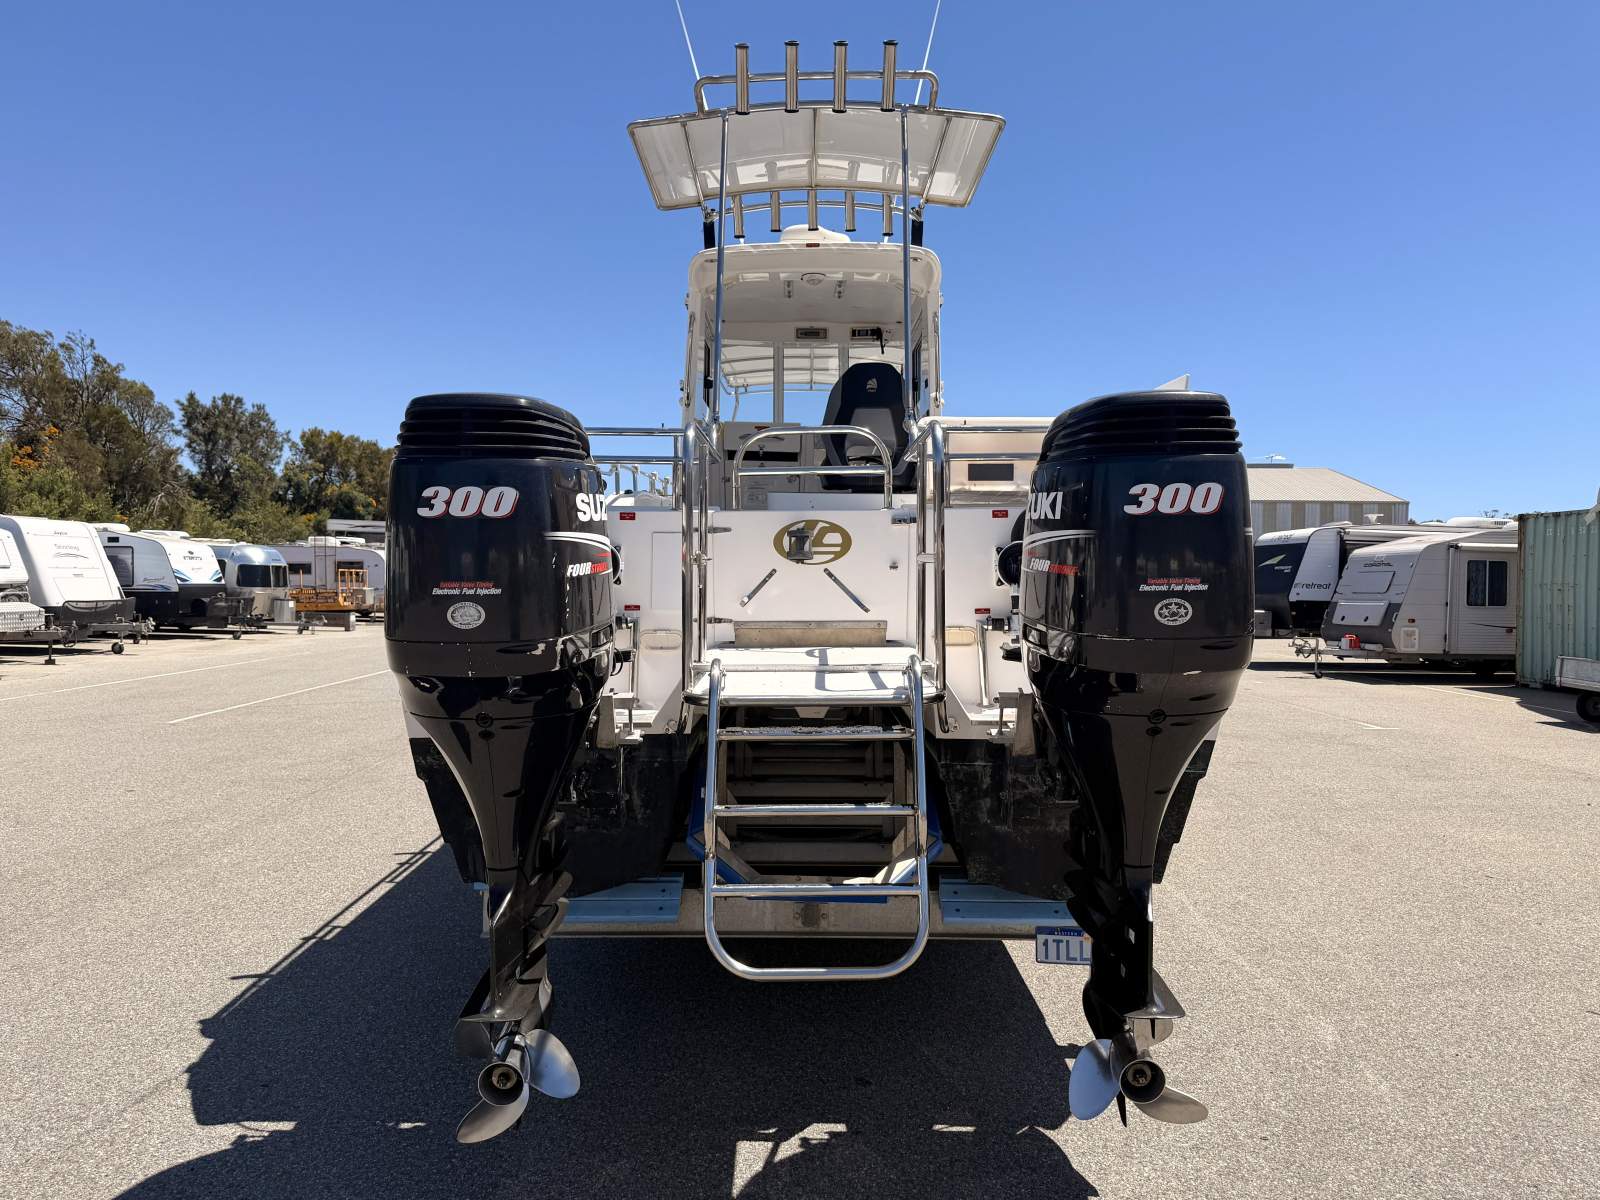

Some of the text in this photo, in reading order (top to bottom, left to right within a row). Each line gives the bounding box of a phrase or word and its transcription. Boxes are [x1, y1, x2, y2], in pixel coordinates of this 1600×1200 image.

[416, 486, 519, 518] 300
[1123, 483, 1224, 515] 300
[1184, 584, 1209, 592] Injection
[1302, 582, 1332, 590] retreat
[476, 588, 502, 596] Injection
